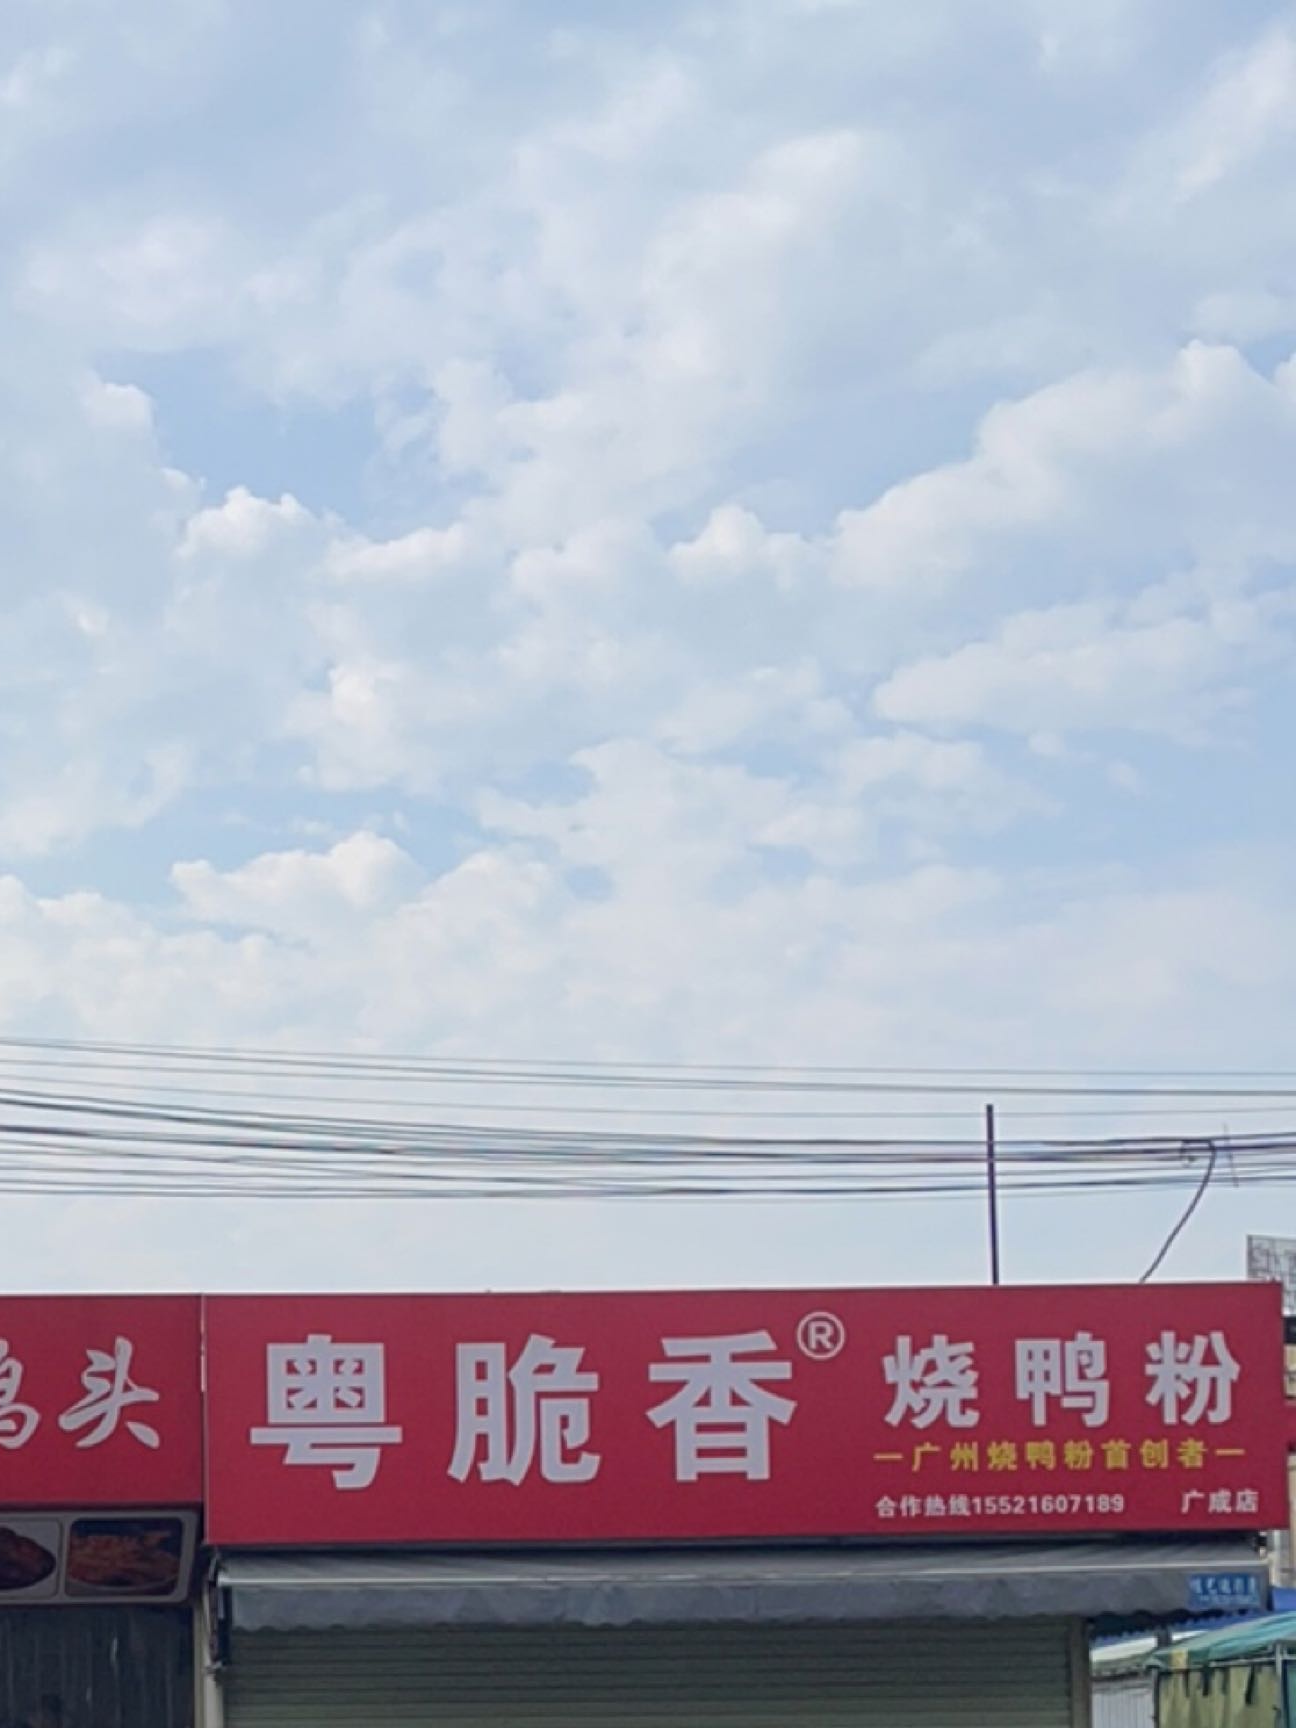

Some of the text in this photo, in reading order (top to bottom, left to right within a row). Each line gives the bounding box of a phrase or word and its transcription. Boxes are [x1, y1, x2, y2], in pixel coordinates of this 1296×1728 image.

[250, 1330, 797, 1488] 粤脆香
[884, 1330, 1242, 1428] 烧鸭粉
